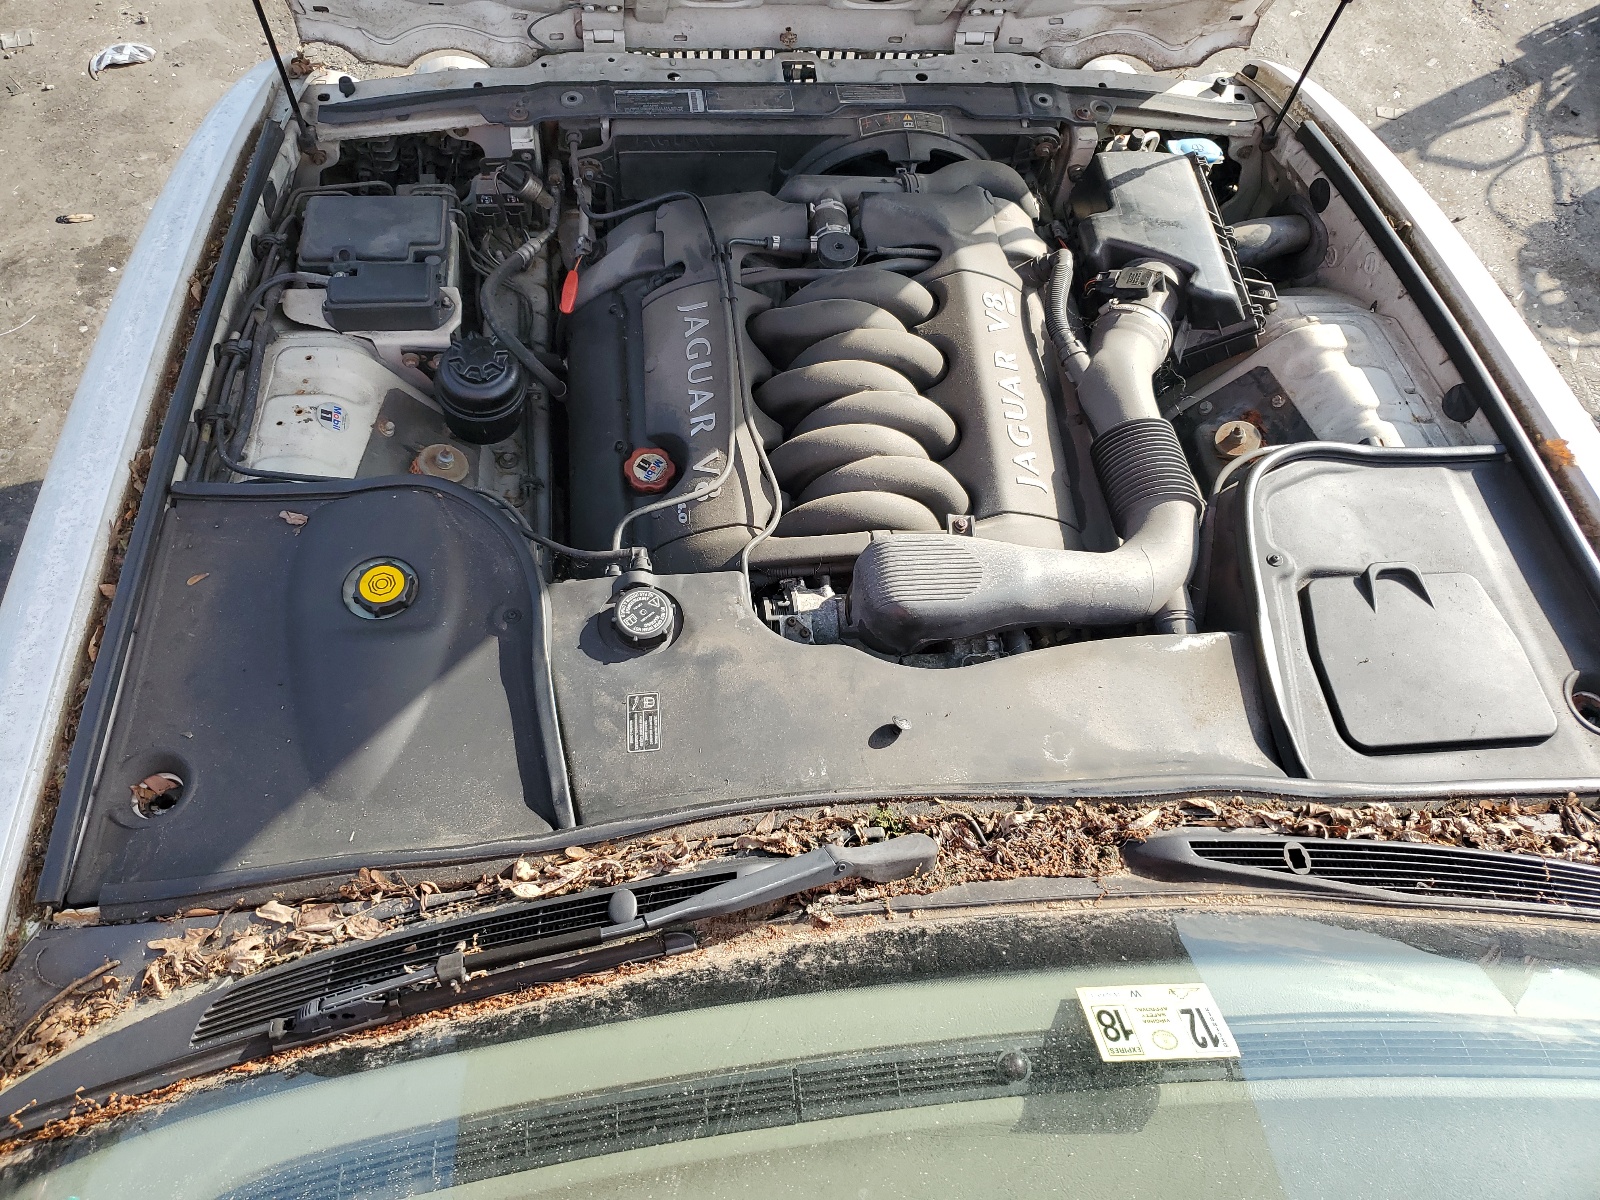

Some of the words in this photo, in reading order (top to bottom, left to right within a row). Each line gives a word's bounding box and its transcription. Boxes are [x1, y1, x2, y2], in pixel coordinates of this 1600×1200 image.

[982, 291, 1009, 332] V8
[677, 301, 717, 437] JAGUAR
[333, 406, 342, 430] Mobil
[993, 350, 1047, 494] JAGUAR
[644, 459, 663, 480] Mobil
[1096, 1009, 1134, 1042] 18
[1179, 1008, 1220, 1049] 12
[1109, 1046, 1141, 1054] EXPIRES
